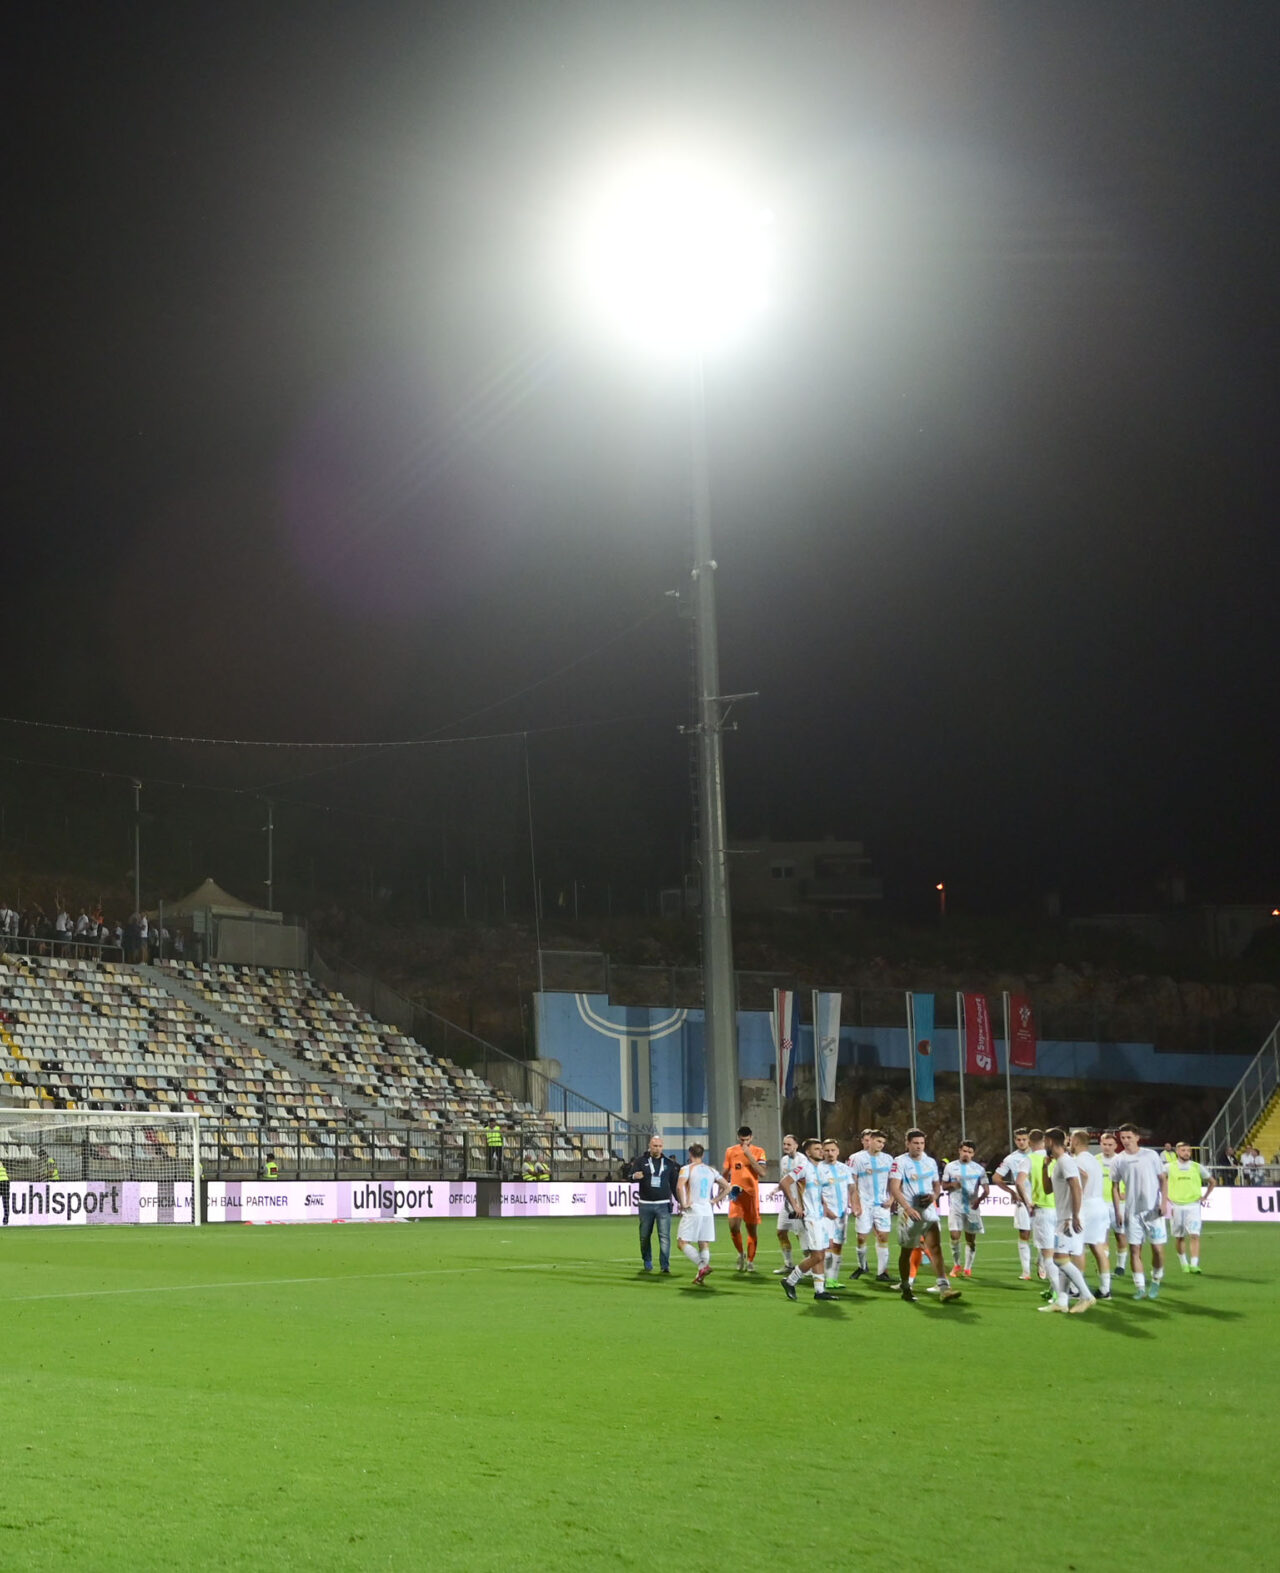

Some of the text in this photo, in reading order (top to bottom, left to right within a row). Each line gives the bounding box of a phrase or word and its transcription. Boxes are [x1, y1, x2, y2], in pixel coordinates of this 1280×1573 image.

[11, 1184, 119, 1221] uhlsport
[139, 1197, 182, 1208] OFFICIAL
[220, 1196, 243, 1207] BALL
[246, 1196, 288, 1206] PARTNER
[353, 1184, 434, 1214] uhlsport
[448, 1194, 477, 1204] OFFICIA
[510, 1194, 527, 1204] BALL
[529, 1194, 560, 1204] PARTNER
[608, 1184, 640, 1207] uhls
